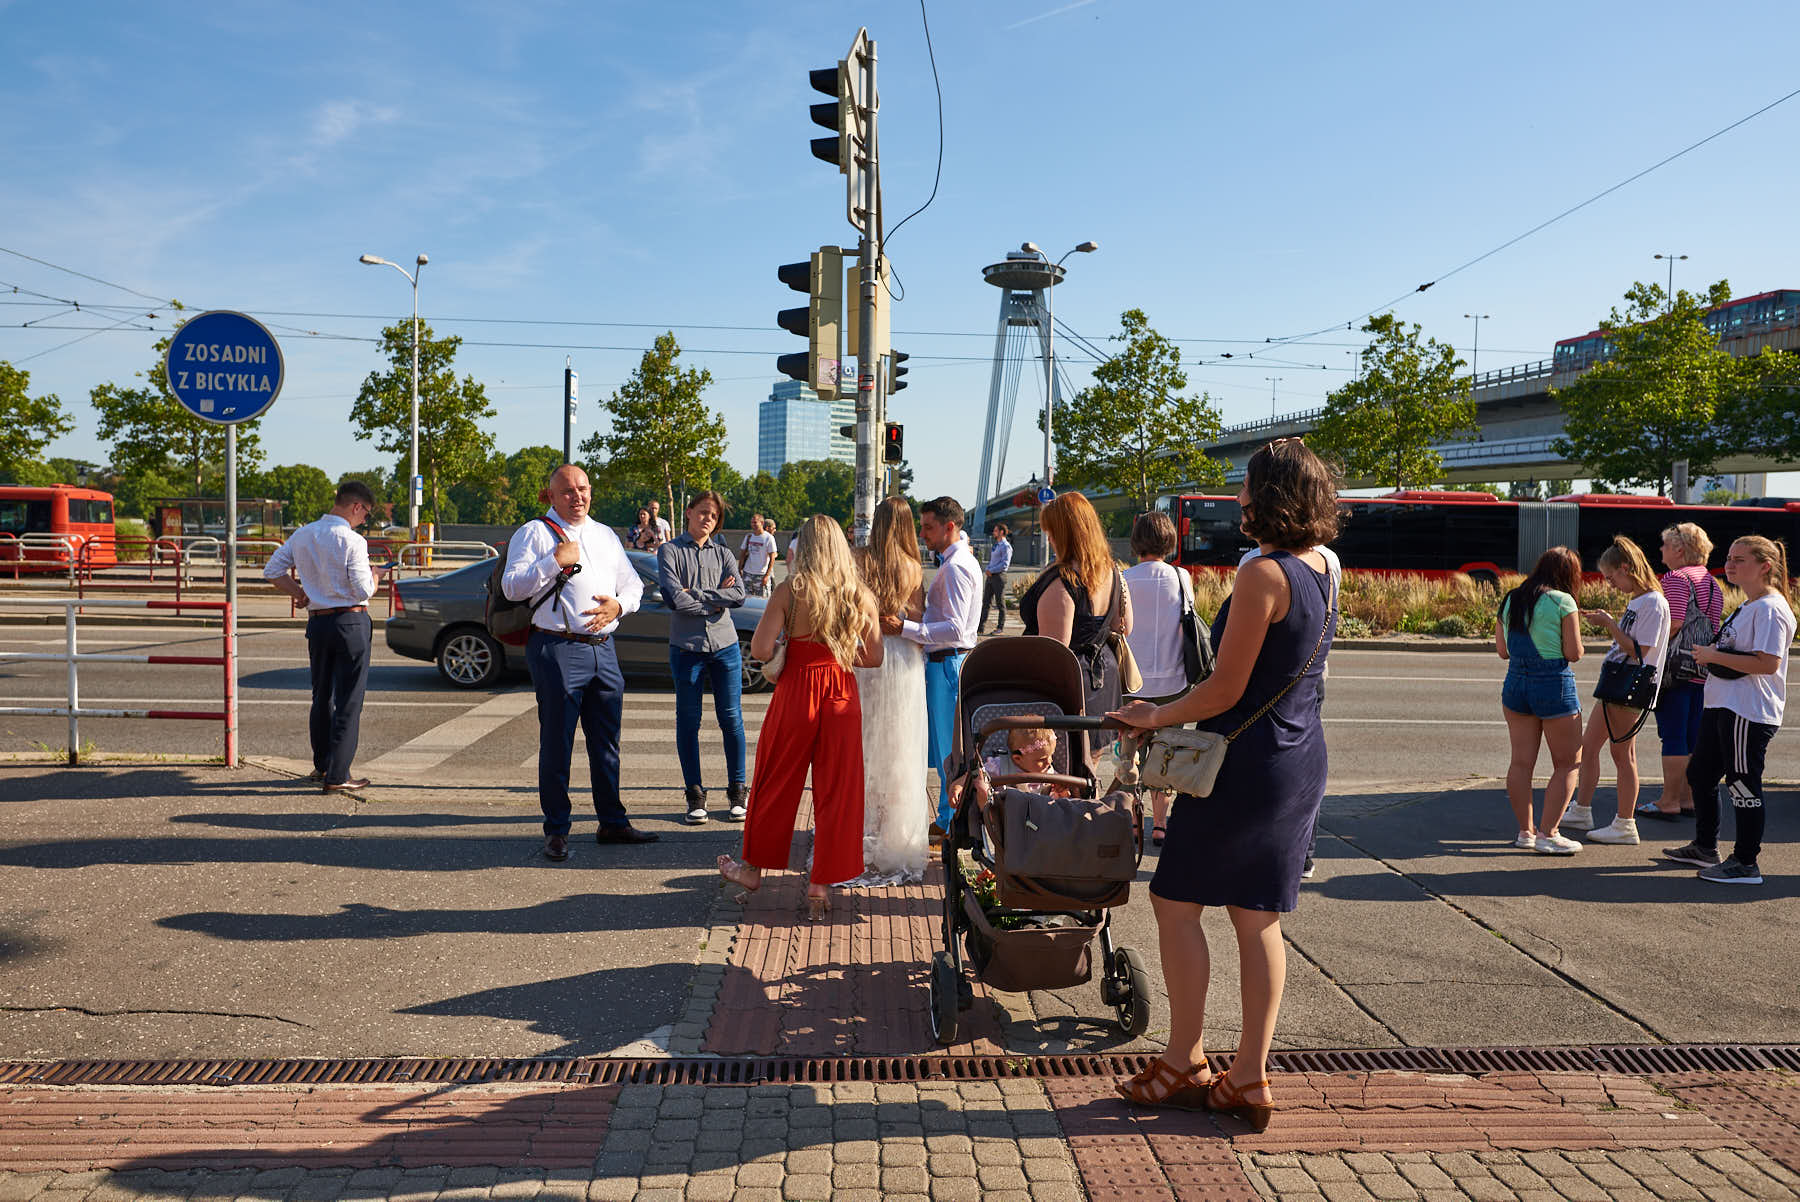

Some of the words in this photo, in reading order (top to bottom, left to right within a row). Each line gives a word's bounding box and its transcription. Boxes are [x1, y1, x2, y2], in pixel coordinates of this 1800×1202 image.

[184, 343, 266, 363] ZOSADNI
[178, 371, 189, 389] Z
[195, 372, 271, 392] BICYKLA
[1731, 797, 1762, 807] idas
